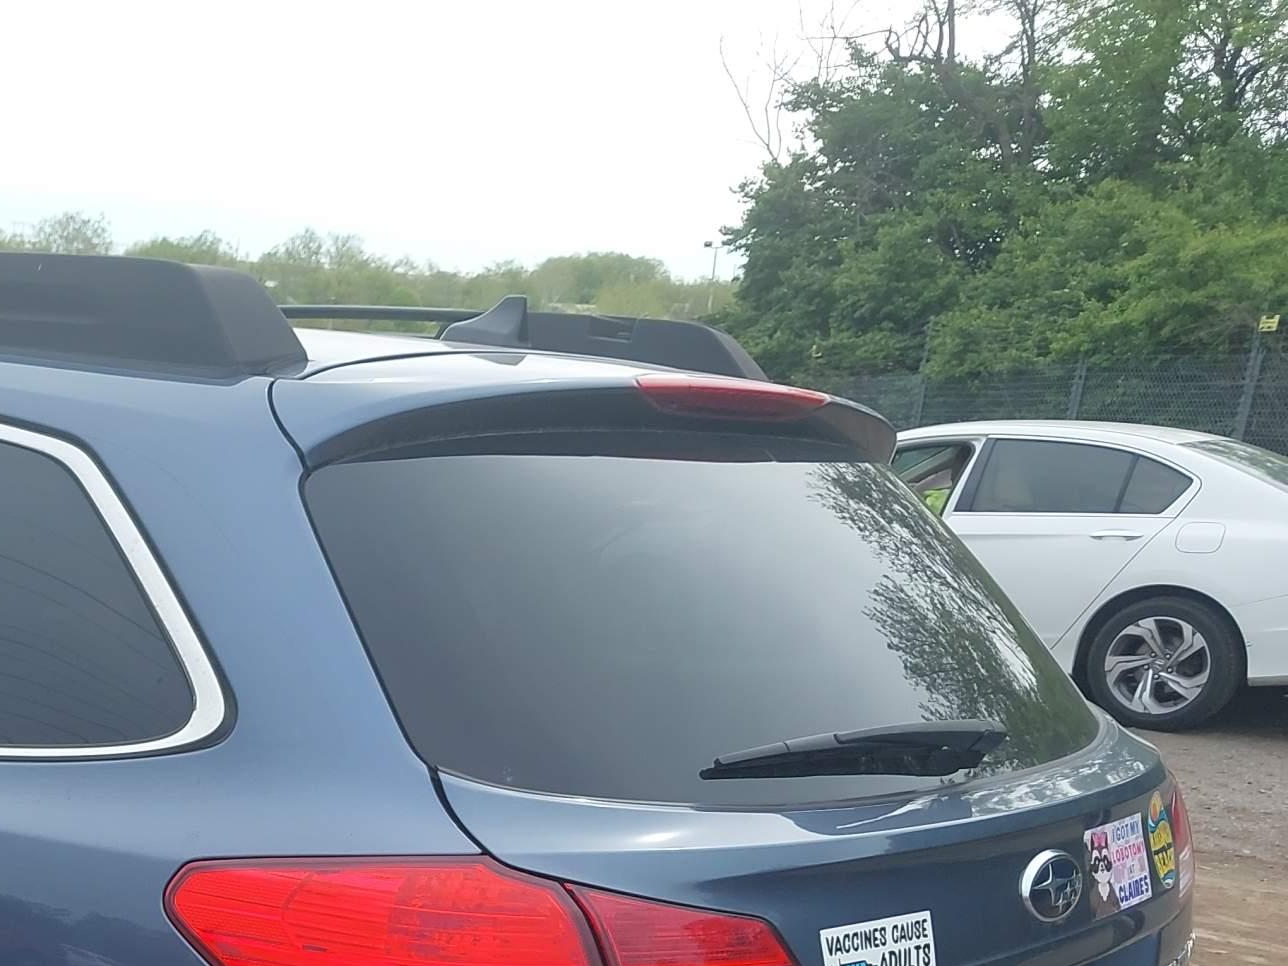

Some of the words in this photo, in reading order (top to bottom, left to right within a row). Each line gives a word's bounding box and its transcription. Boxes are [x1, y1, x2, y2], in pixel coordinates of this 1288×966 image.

[1116, 823, 1130, 842] GOT
[1130, 820, 1140, 838] MY
[1112, 841, 1145, 863] LOBOTOMY
[1128, 863, 1135, 874] AT
[1118, 874, 1151, 903] CLAIRES
[825, 926, 888, 957] VACCINES
[891, 918, 929, 944] CAUSE
